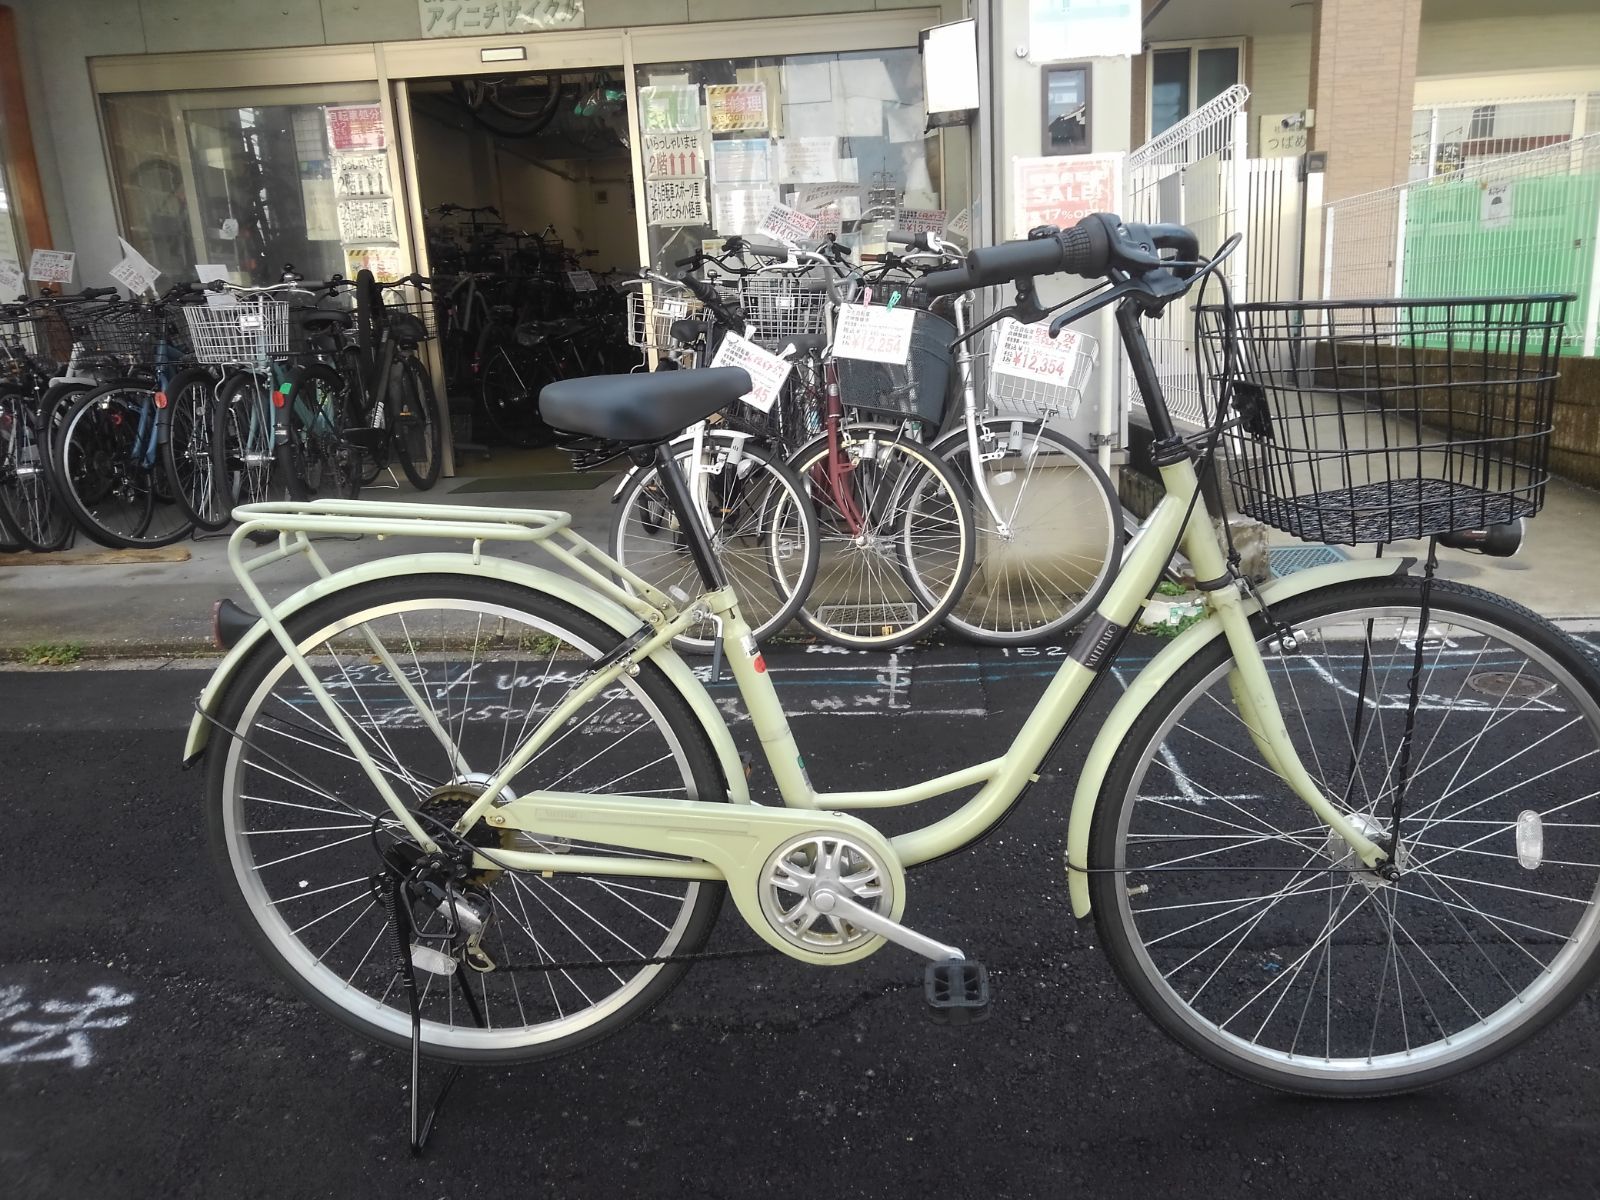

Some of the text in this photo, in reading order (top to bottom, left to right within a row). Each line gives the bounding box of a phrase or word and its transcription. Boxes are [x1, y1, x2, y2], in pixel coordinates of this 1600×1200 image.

[645, 134, 697, 150] いらっしゃいませ
[649, 152, 668, 176] 2階
[1012, 351, 1065, 377] ¥12,354
[1002, 646, 1067, 657] 152
